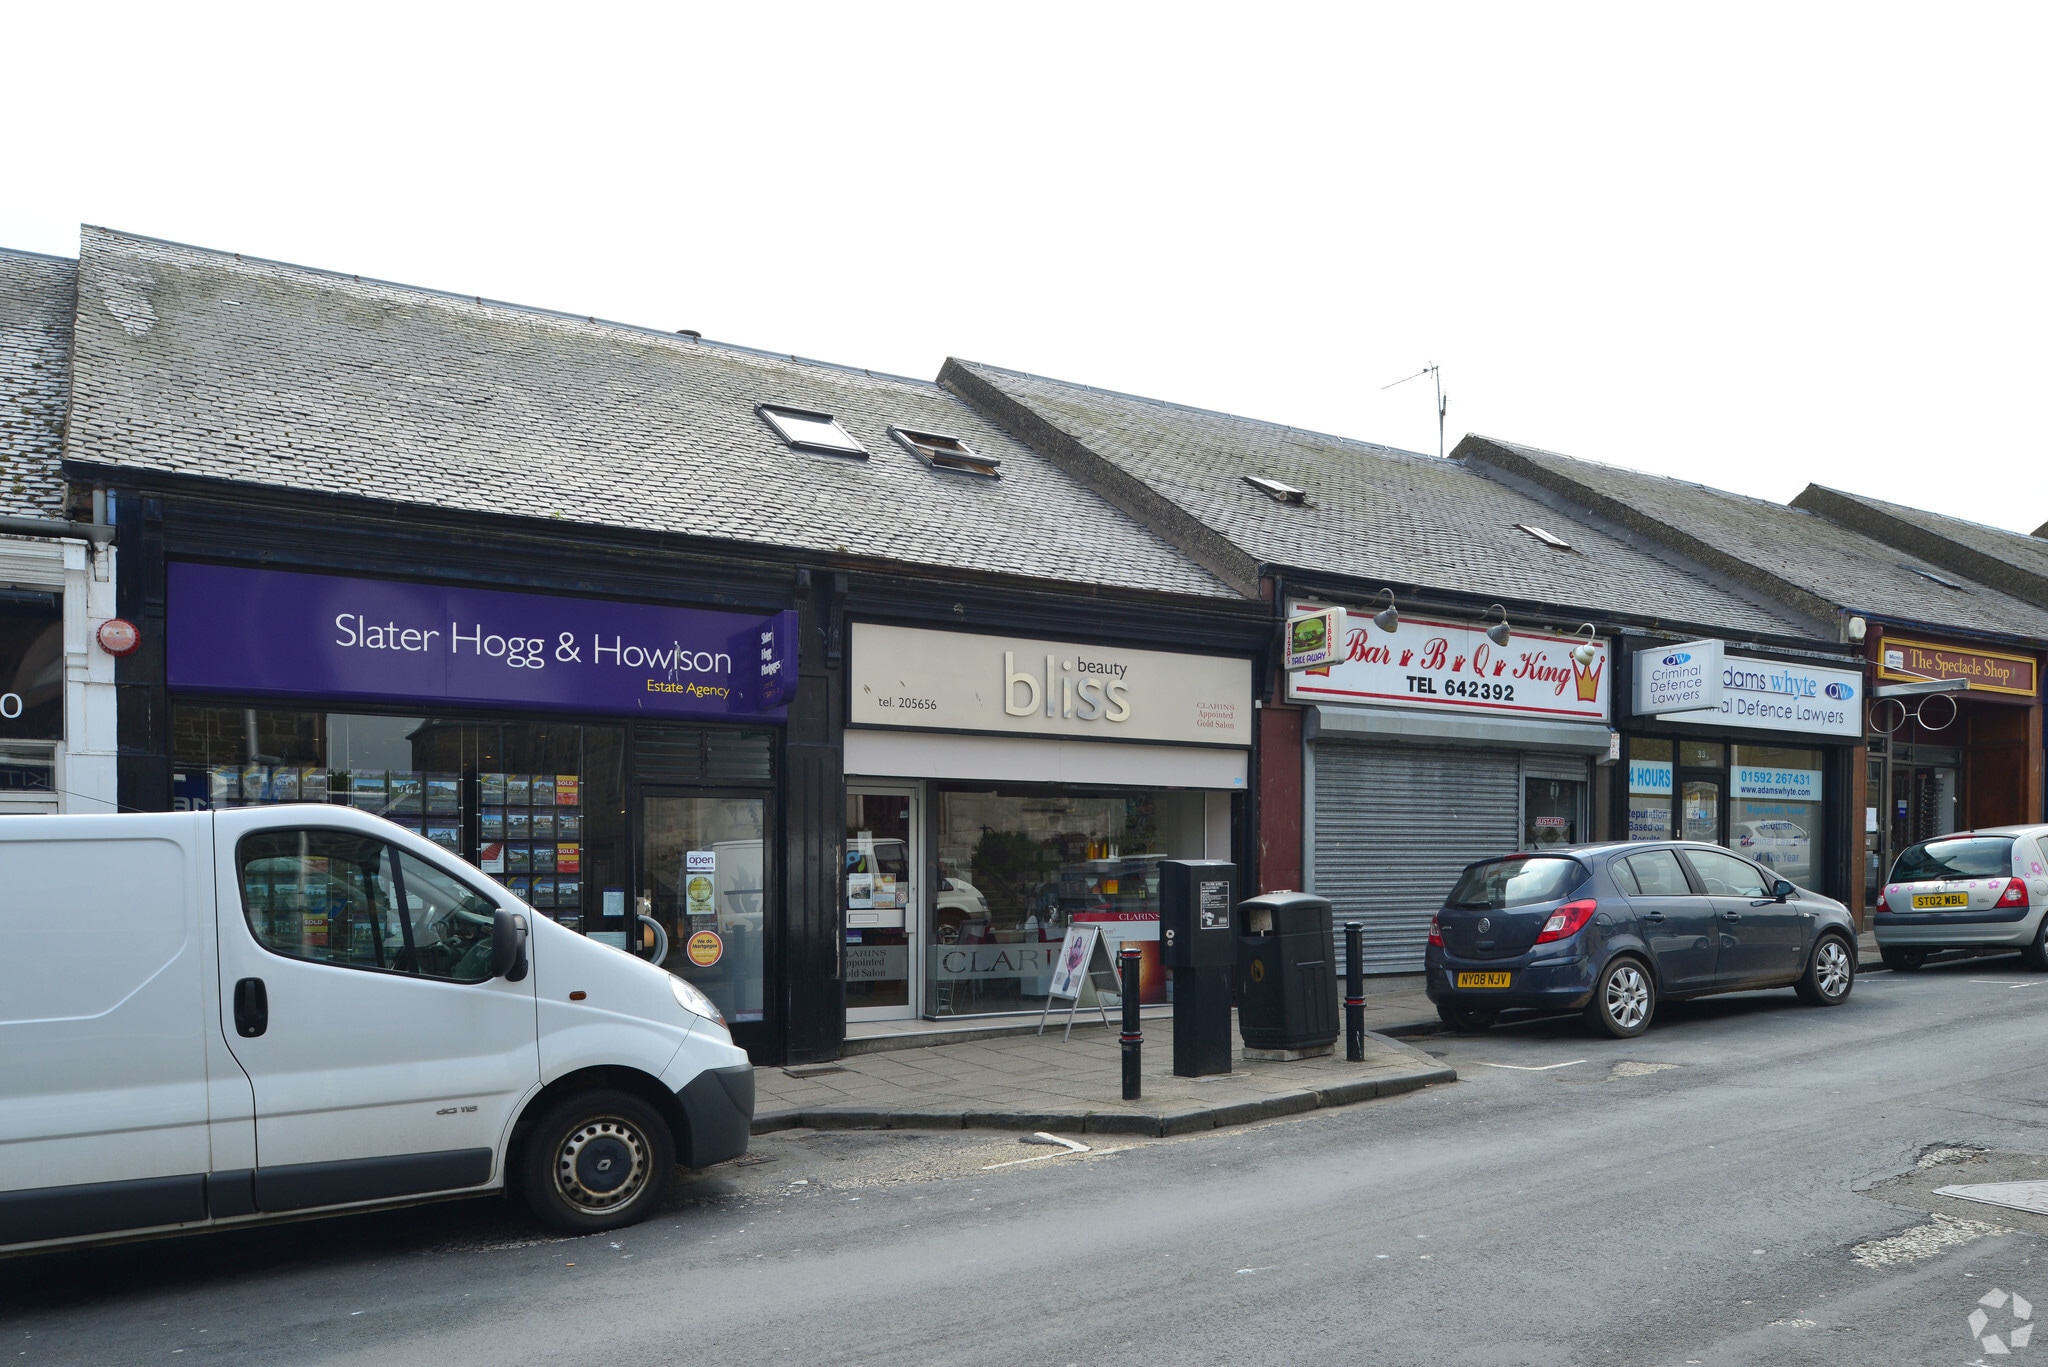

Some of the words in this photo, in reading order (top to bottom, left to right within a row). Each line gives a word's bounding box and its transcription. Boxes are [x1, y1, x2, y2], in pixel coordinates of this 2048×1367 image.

[335, 613, 439, 652] Slater
[452, 621, 545, 669] Hogg
[556, 632, 581, 663] &
[594, 634, 731, 674] Howison
[1077, 656, 1128, 680] beauty
[1346, 627, 1391, 664] Bar
[1421, 638, 1449, 670] B
[1473, 643, 1491, 678] Q
[1513, 651, 1571, 696] King
[1910, 649, 1932, 669] The
[1935, 652, 1981, 678] Spectacle
[1984, 658, 2010, 685] Shop
[1652, 664, 1701, 681] Criminal
[647, 678, 684, 694] Estate
[686, 682, 730, 699] Agency
[1004, 651, 1132, 723] bliss
[1406, 675, 1437, 695] TEL
[1444, 679, 1515, 701] 642392
[1650, 677, 1702, 693] Defence
[1723, 666, 1766, 690] dams
[1770, 670, 1817, 700] whyte
[878, 697, 895, 708] tel.
[898, 698, 937, 711] 205656
[1652, 691, 1700, 704] Lawyers
[1196, 702, 1235, 711] CLARINS
[1737, 698, 1793, 720] Defence
[1797, 707, 1844, 726] Lawyers
[1199, 710, 1234, 719] Appointed
[1216, 721, 1235, 729] Salon
[1637, 767, 1671, 788] HOURS
[1741, 770, 1772, 783] 01592
[1775, 772, 1810, 785] 267431
[1740, 785, 1811, 797] www.adamswhyte.com
[1629, 821, 1653, 832] Based
[1654, 824, 1664, 832] on
[689, 856, 714, 865] open
[1766, 852, 1781, 862] The
[1783, 852, 1800, 862] Year
[1917, 896, 1942, 906] ST02
[1945, 895, 1965, 905] WBL
[1119, 913, 1160, 921] CLARINS
[846, 949, 887, 958] LARINS
[942, 948, 1061, 973] CLARI
[846, 958, 885, 968] ppointed
[846, 970, 859, 978] old
[862, 969, 886, 978] Salon
[1462, 973, 1486, 985] NY08
[1487, 973, 1507, 985] NJV
